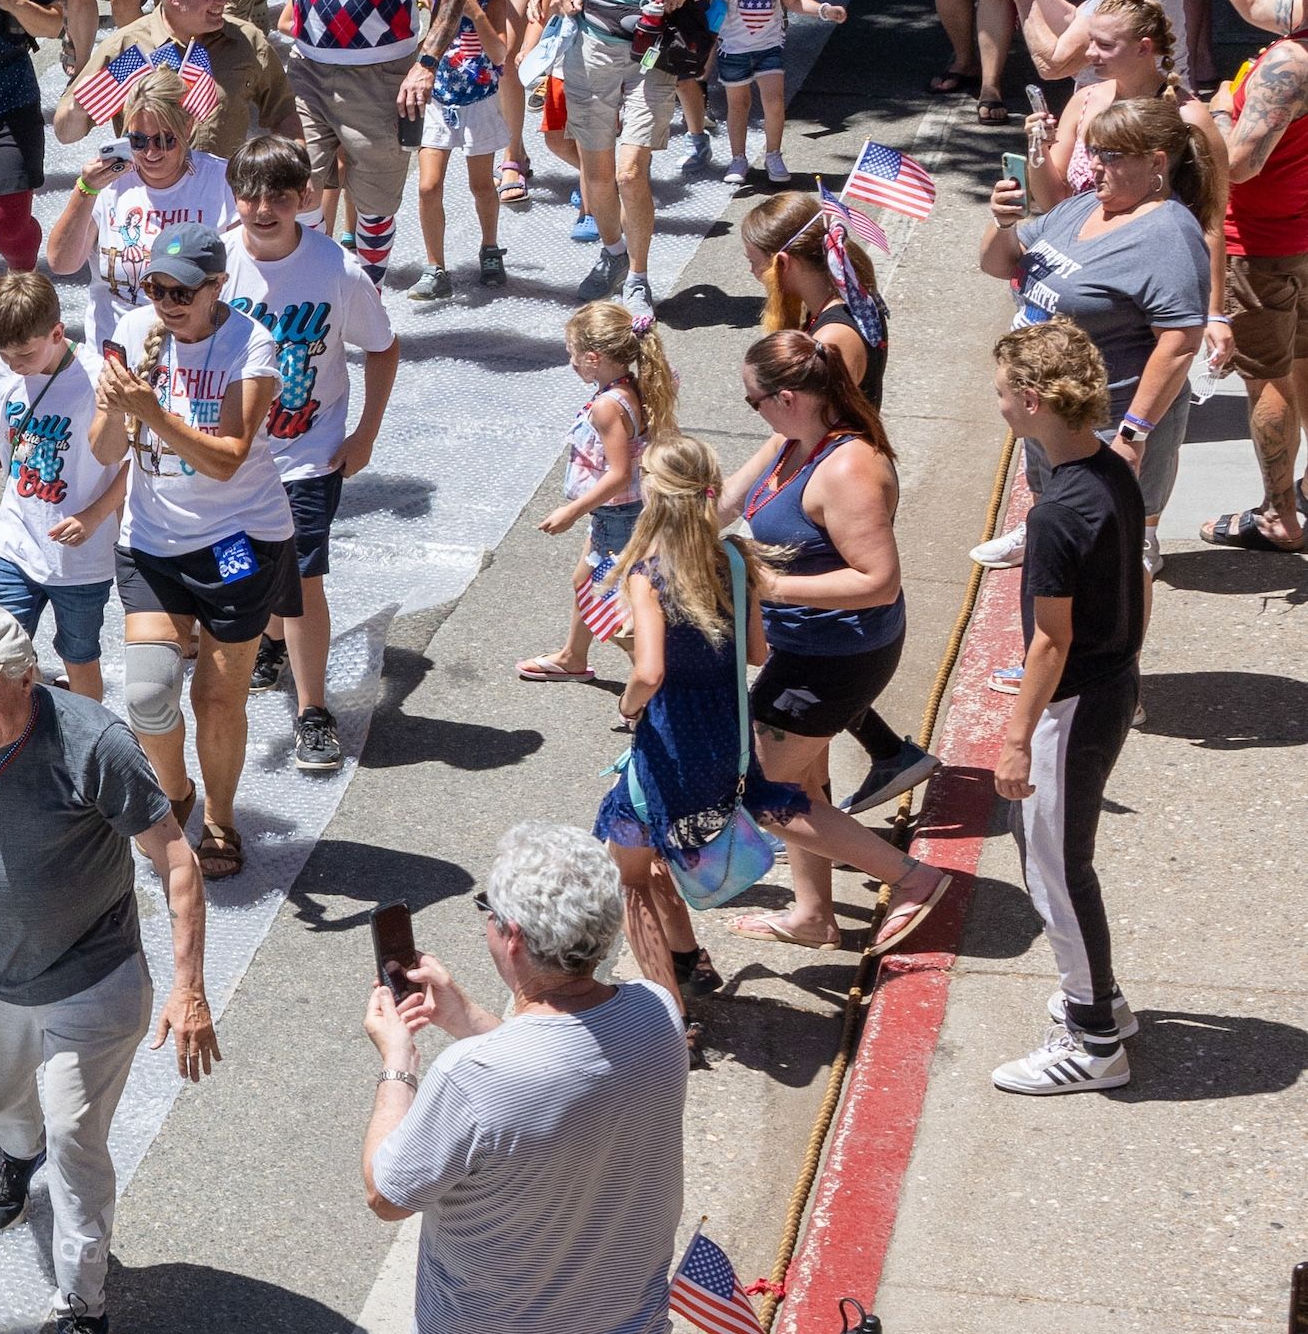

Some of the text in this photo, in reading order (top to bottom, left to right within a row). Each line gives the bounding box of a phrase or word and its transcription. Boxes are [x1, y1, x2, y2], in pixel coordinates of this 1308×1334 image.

[170, 367, 226, 400] CHILL
[189, 399, 221, 424] THE
[17, 464, 69, 505] Out
